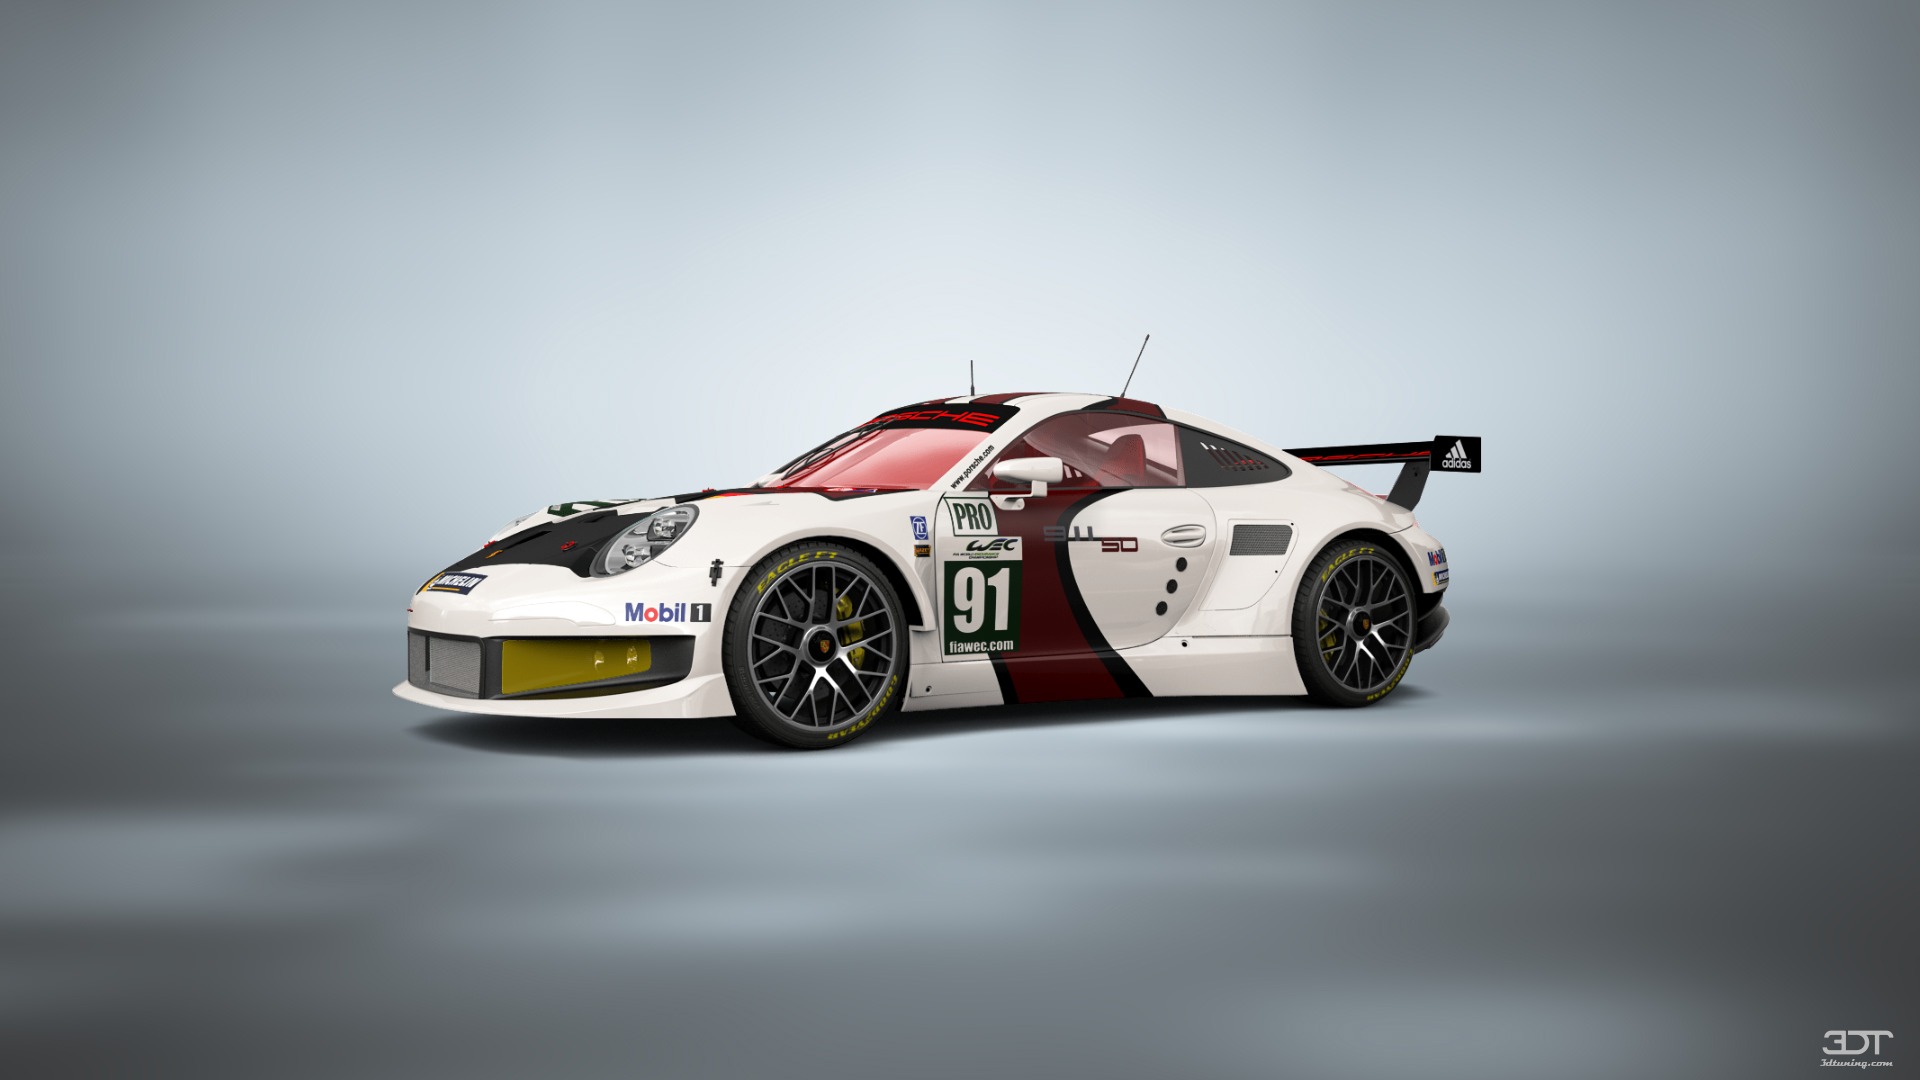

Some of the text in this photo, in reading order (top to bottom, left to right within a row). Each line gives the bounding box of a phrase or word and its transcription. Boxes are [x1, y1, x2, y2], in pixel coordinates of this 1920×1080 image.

[950, 444, 995, 490] www.porsche.com
[1441, 457, 1472, 469] adidas
[952, 502, 993, 531] PRO
[966, 538, 1019, 552] WEC
[757, 552, 811, 594] EAGLE
[624, 602, 687, 623] Mobil
[953, 566, 1010, 634] 91
[949, 640, 1014, 654] fiawec.com
